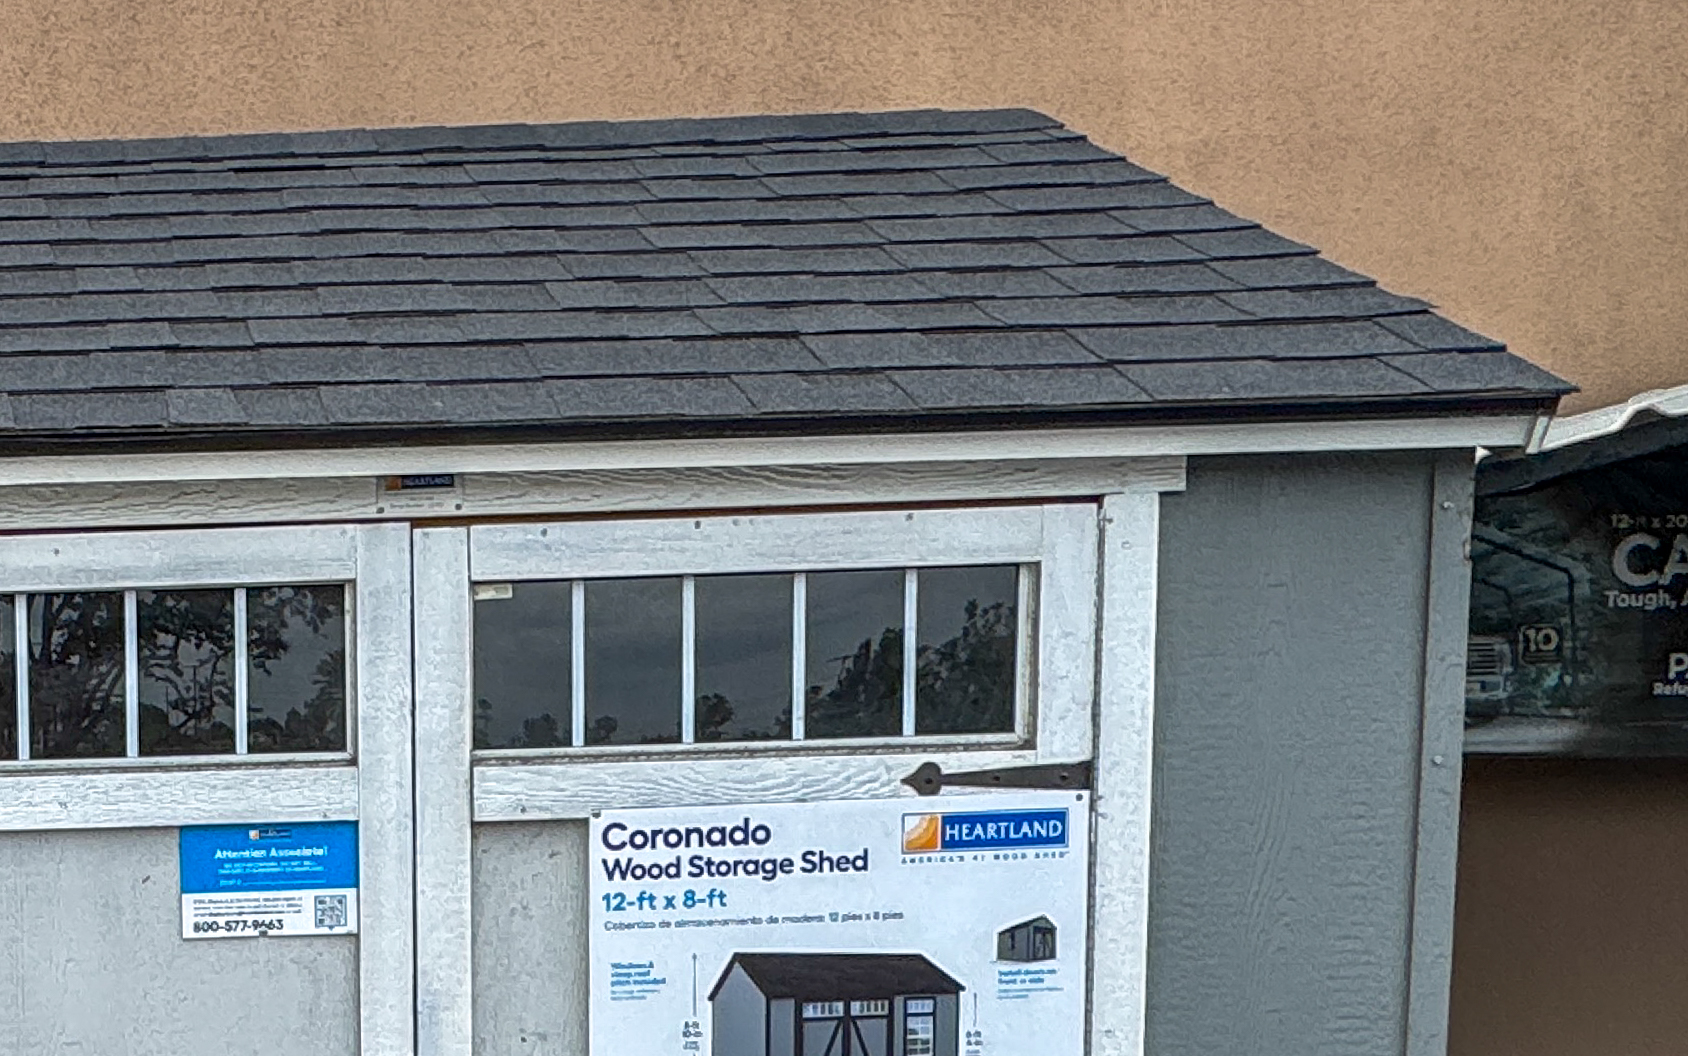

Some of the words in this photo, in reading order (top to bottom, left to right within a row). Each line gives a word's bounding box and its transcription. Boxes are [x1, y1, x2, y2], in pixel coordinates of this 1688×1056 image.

[1604, 588, 1677, 610] Tough,
[1525, 627, 1560, 652] 10
[1667, 652, 1688, 680] P
[601, 817, 772, 851] Coronado
[944, 819, 1063, 841] HEARTLAND
[601, 855, 682, 882] Wood
[687, 853, 795, 881] Storage
[800, 848, 869, 874] Shed
[601, 890, 657, 913] 12-ft
[662, 894, 677, 911] x
[681, 888, 728, 909] 8-ft
